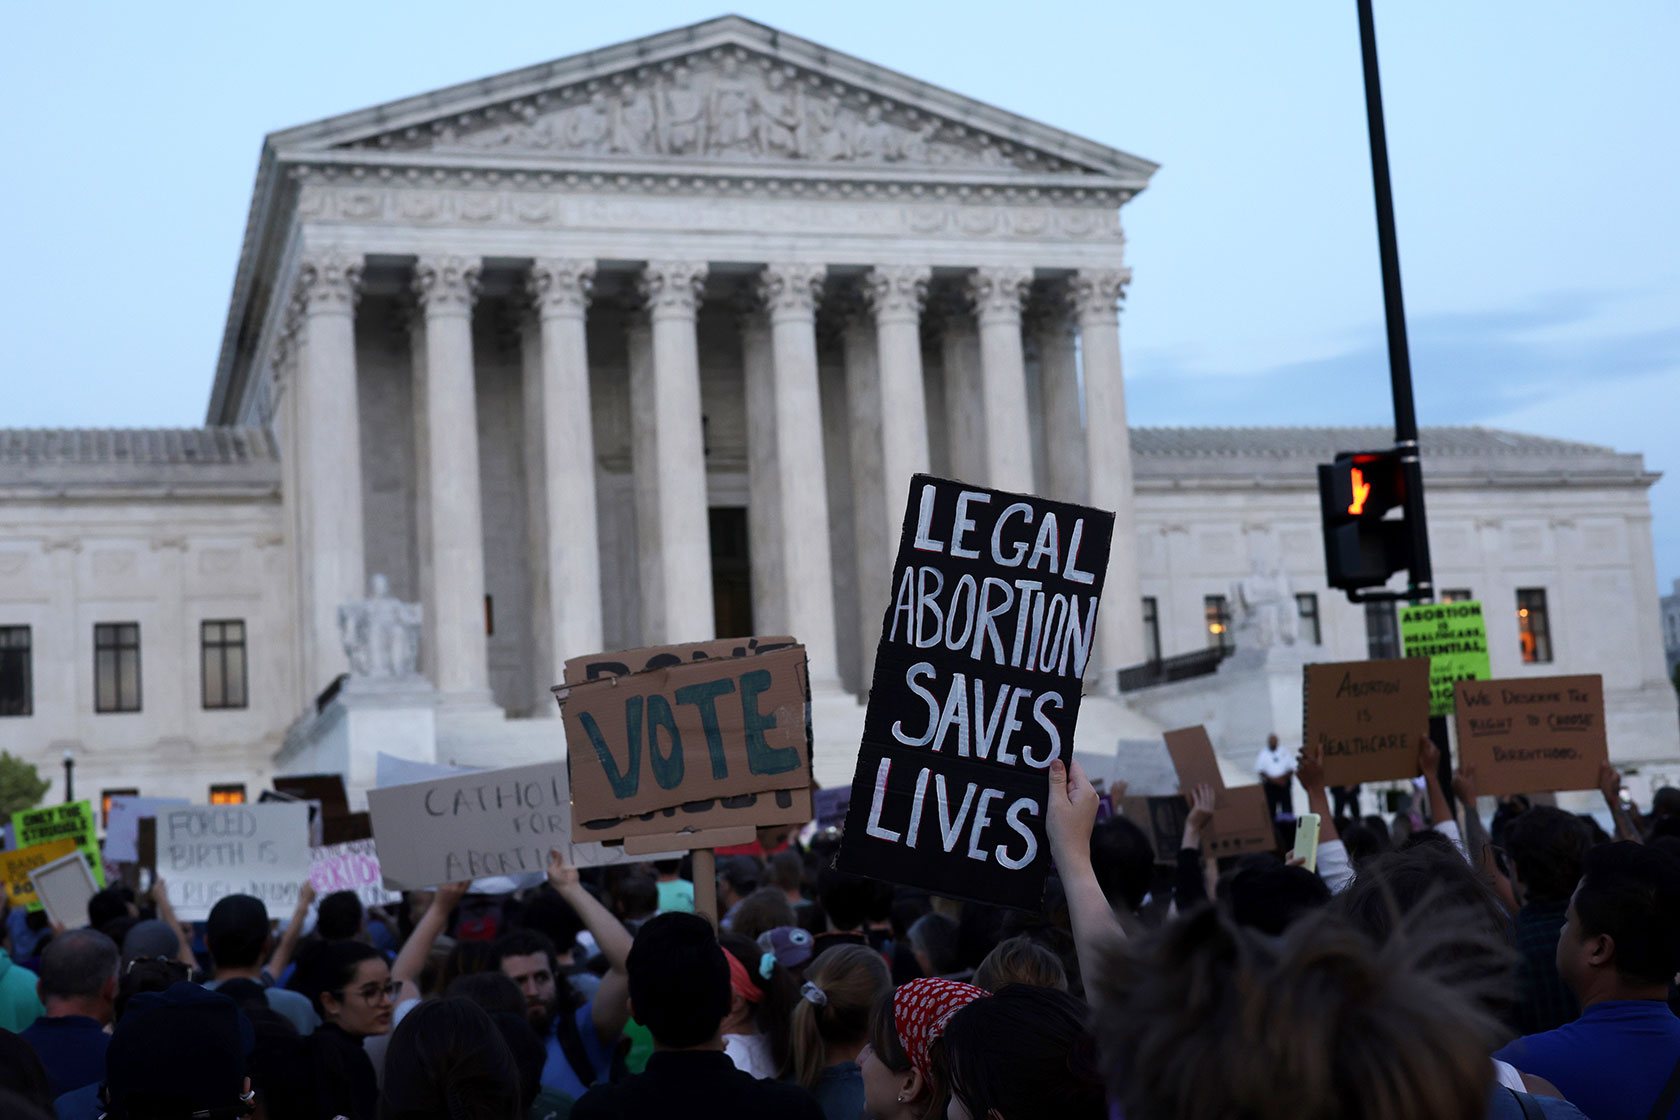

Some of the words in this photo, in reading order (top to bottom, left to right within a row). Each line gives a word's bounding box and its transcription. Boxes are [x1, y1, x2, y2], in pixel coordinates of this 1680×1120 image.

[913, 484, 1095, 584] LEGAL
[889, 565, 1097, 679] ABORTION
[1403, 605, 1482, 622] ABORTION
[578, 669, 801, 800] VOTE
[891, 661, 1063, 768] SAVES
[167, 809, 257, 841] FORCED
[425, 776, 569, 816] CATHOL
[512, 812, 566, 835] FOR
[866, 757, 1039, 870] LIVES
[168, 841, 245, 872] BIRTH
[258, 840, 279, 864] IS
